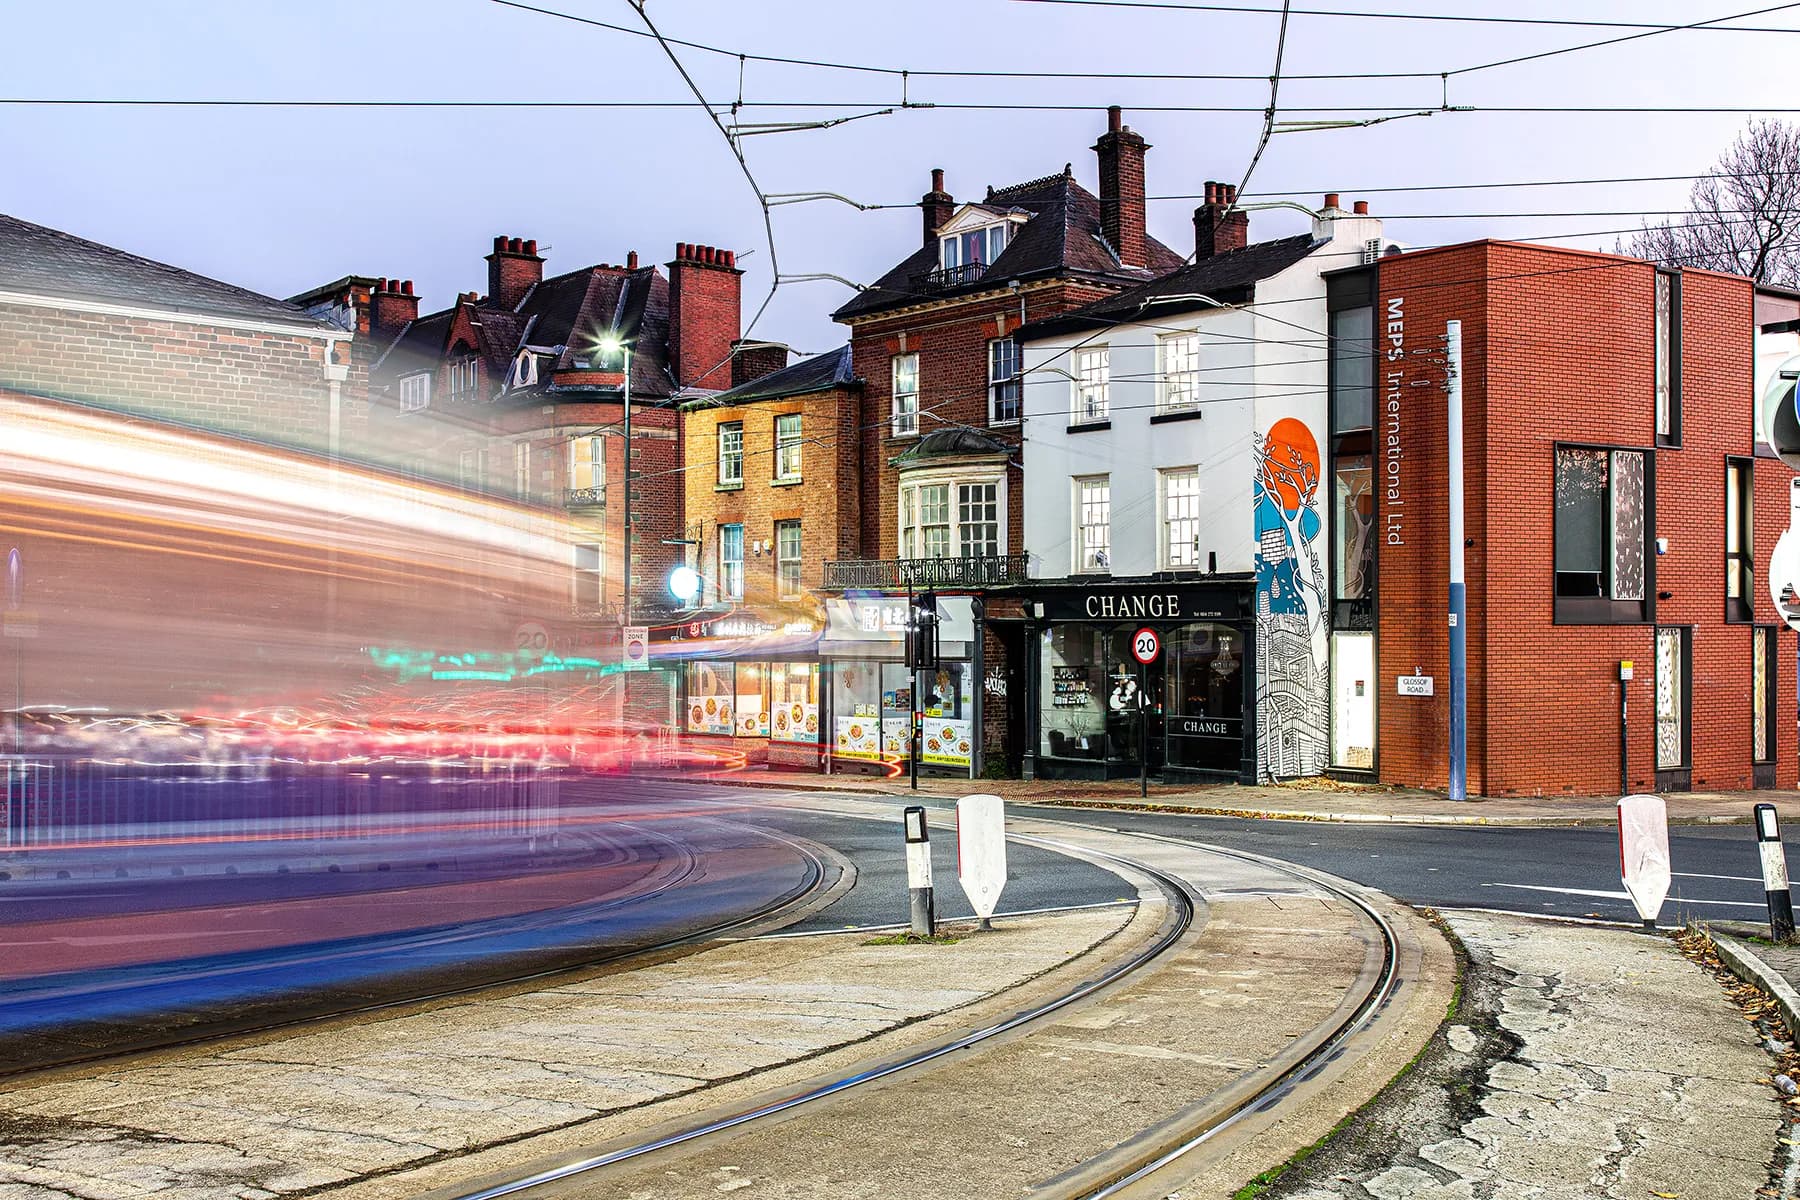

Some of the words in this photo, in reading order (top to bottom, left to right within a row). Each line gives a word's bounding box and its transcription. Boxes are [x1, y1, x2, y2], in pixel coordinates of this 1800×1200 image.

[1387, 297, 1404, 361] MEPS
[1387, 371, 1404, 505] International
[1387, 513, 1405, 545] Ltd
[1085, 594, 1181, 618] CHANGE
[517, 631, 548, 649] 20
[1137, 638, 1156, 653] 20
[1406, 686, 1425, 694] ROAD
[1183, 721, 1228, 734] CHANGE
